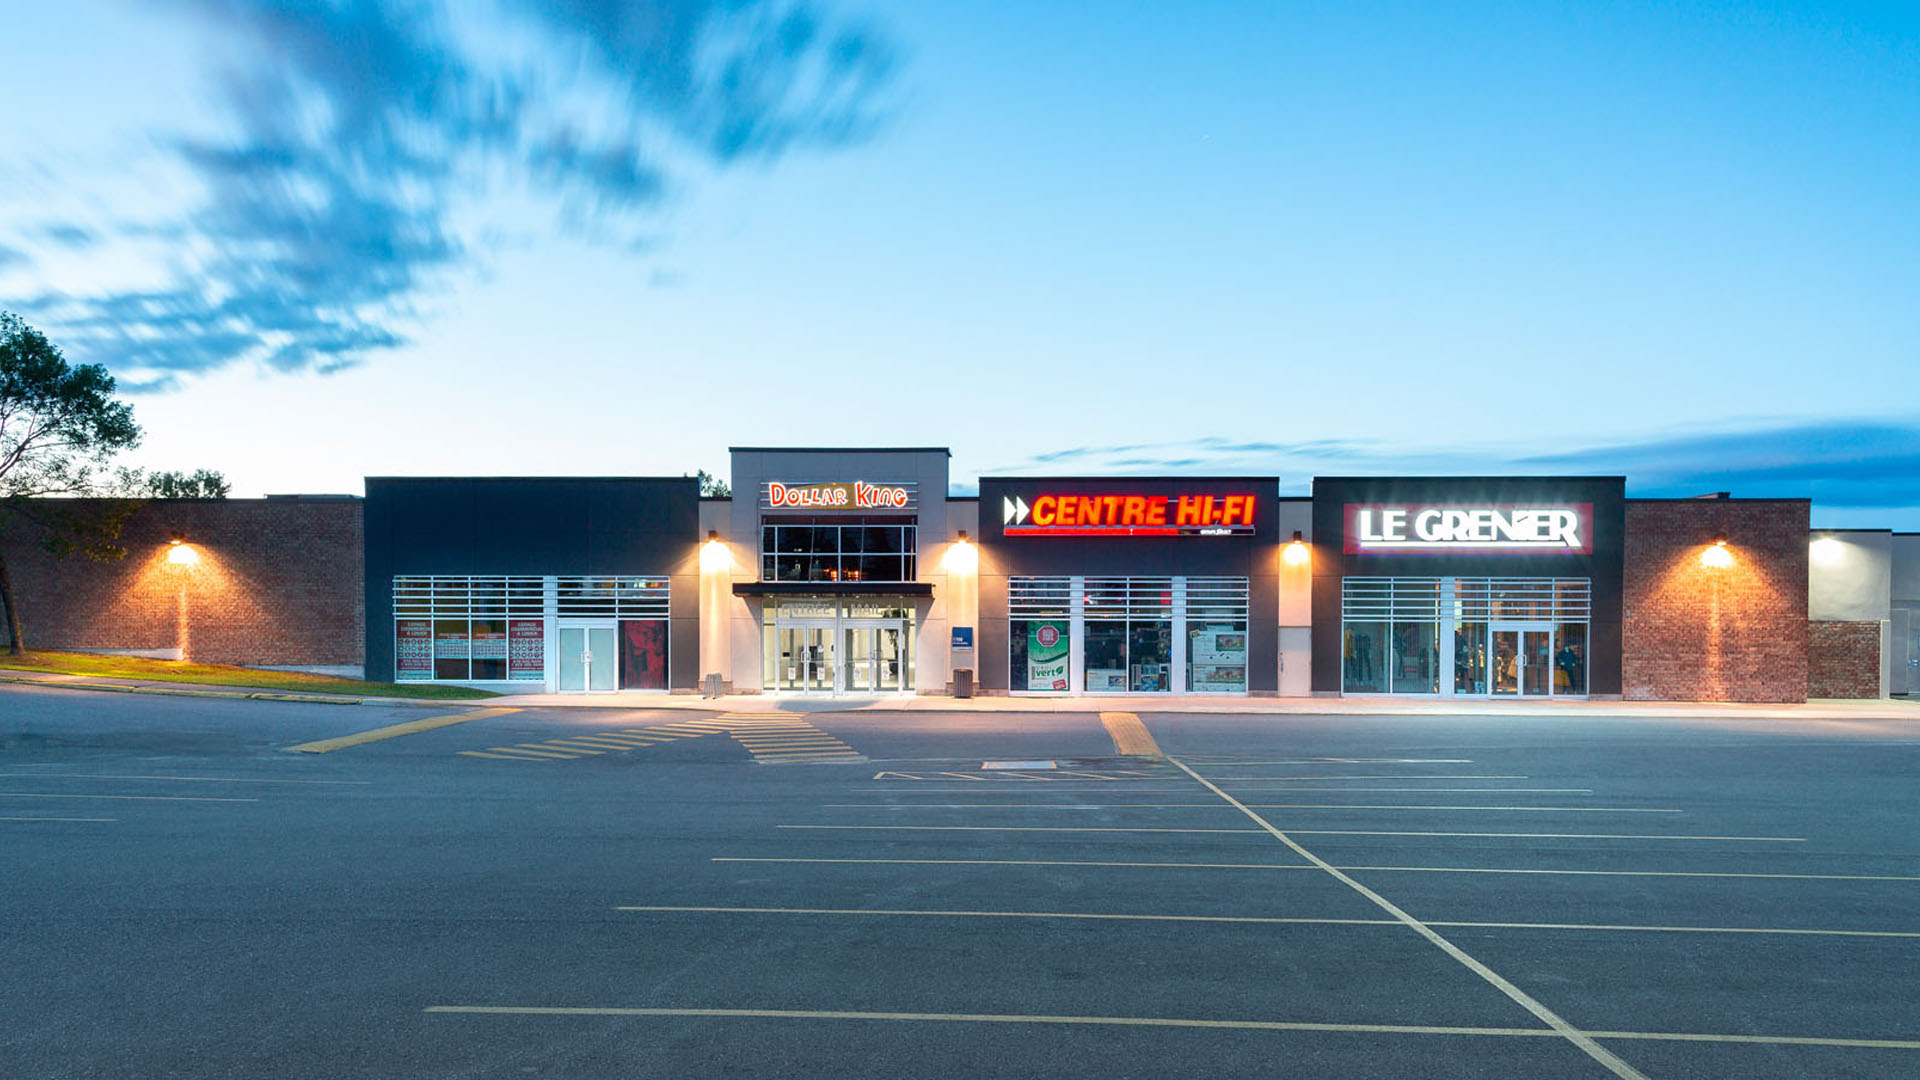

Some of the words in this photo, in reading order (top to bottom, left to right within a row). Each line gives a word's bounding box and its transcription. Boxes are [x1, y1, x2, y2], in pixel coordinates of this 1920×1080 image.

[1032, 495, 1169, 526] CENTRE
[1176, 495, 1256, 526] HI-FI
[1360, 510, 1406, 541] LE
[1415, 510, 1582, 547] GRENIER
[851, 603, 881, 616] MAIL
[1035, 668, 1056, 677] vert
